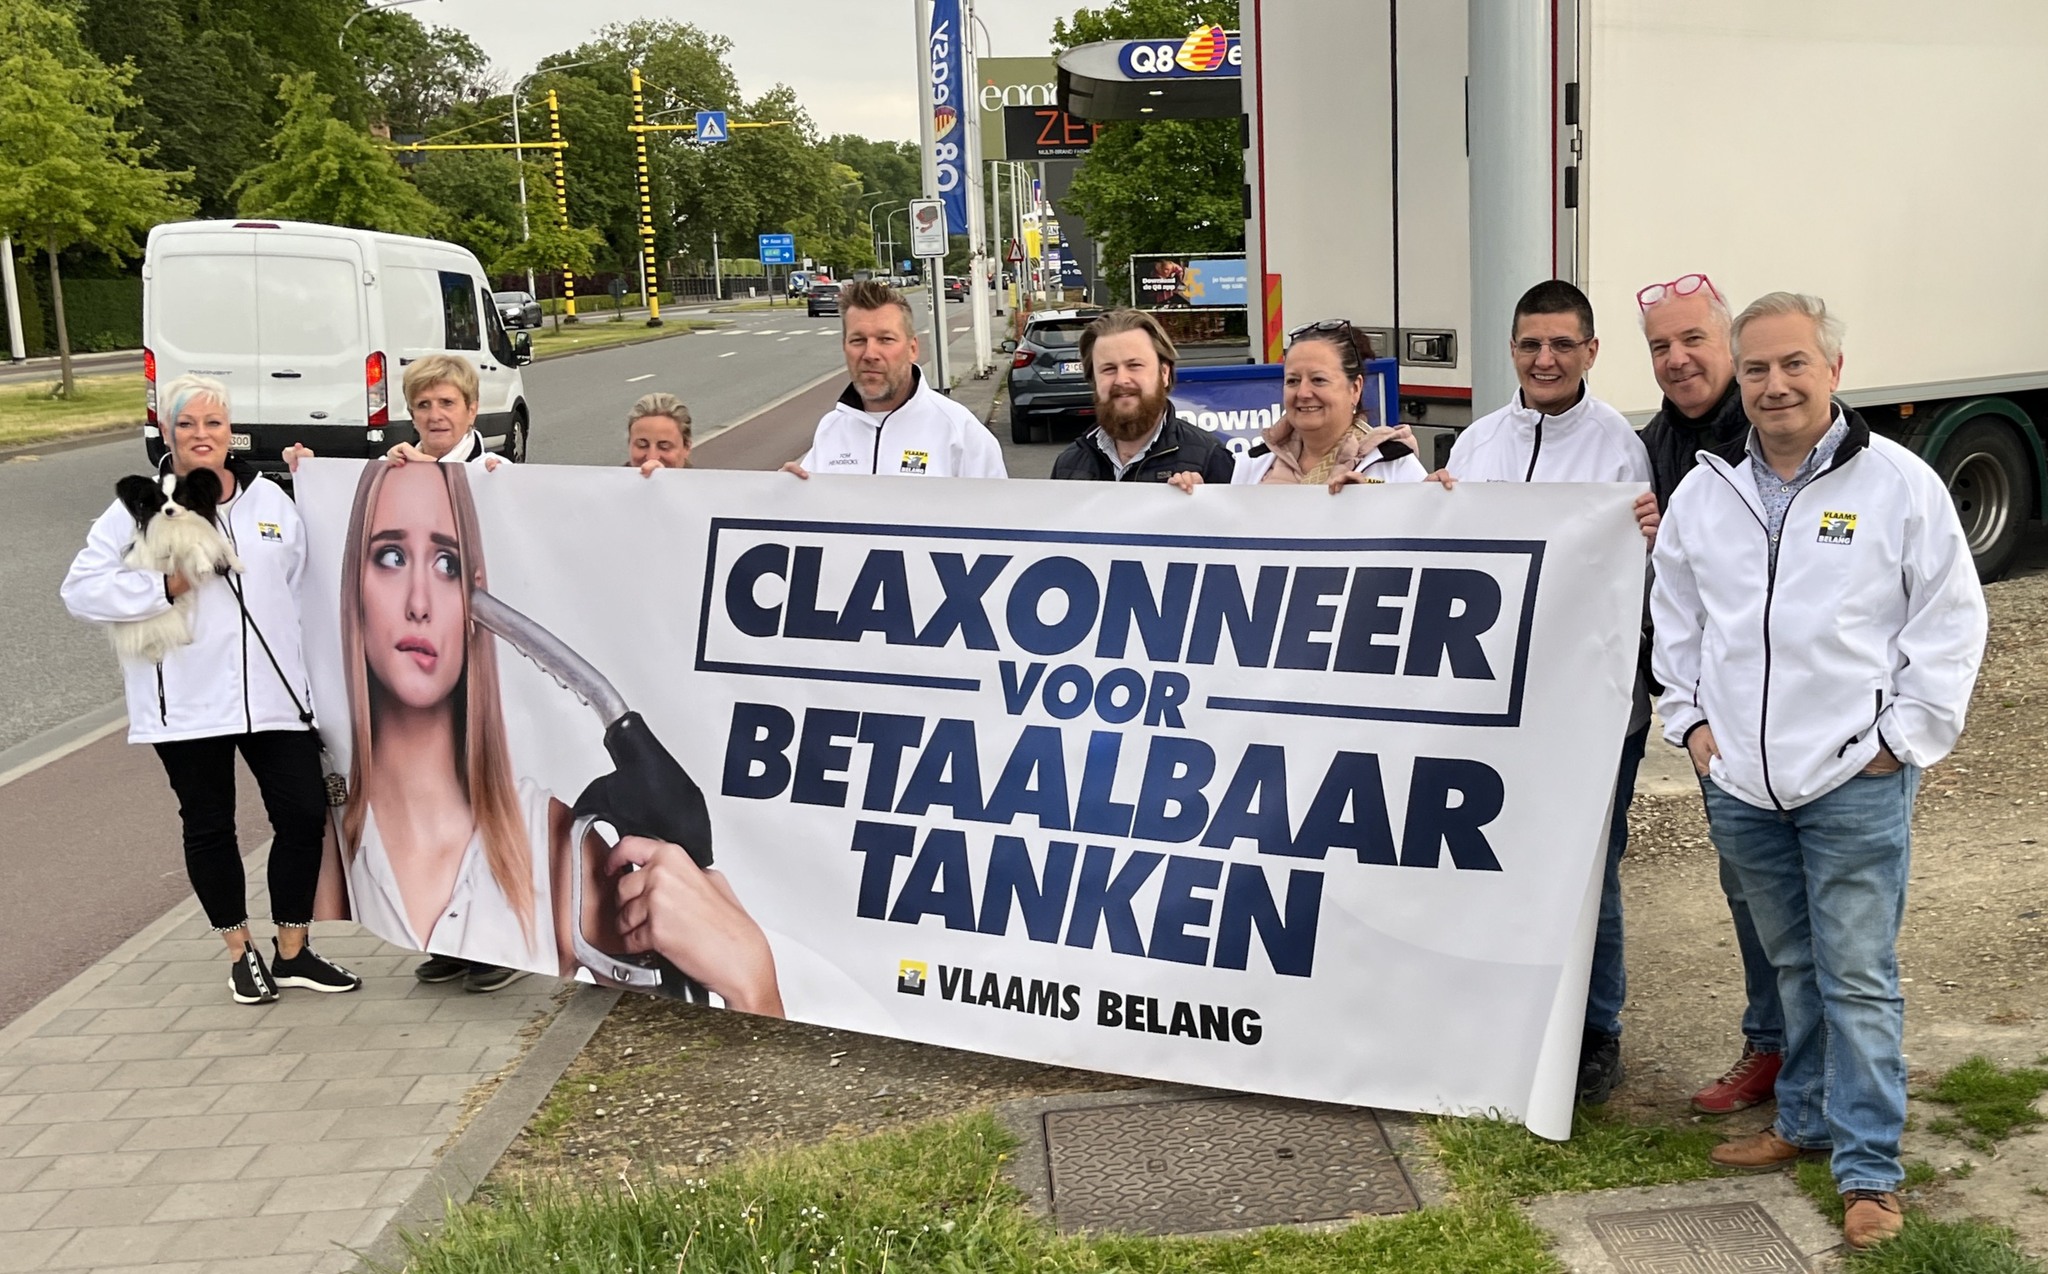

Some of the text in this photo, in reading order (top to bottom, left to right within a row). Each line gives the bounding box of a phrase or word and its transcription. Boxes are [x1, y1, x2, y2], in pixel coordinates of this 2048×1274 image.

[1131, 45, 1174, 73] Q8
[1818, 535, 1850, 544] BELANG
[1823, 511, 1856, 520] VLAAMS
[725, 543, 1501, 681] CLAXONNEER
[998, 660, 1190, 730] VOOR
[721, 702, 1505, 873] BETAALBAAR
[850, 820, 1325, 979] TANKEN
[937, 964, 1263, 1046] VLAAMS BELANG
